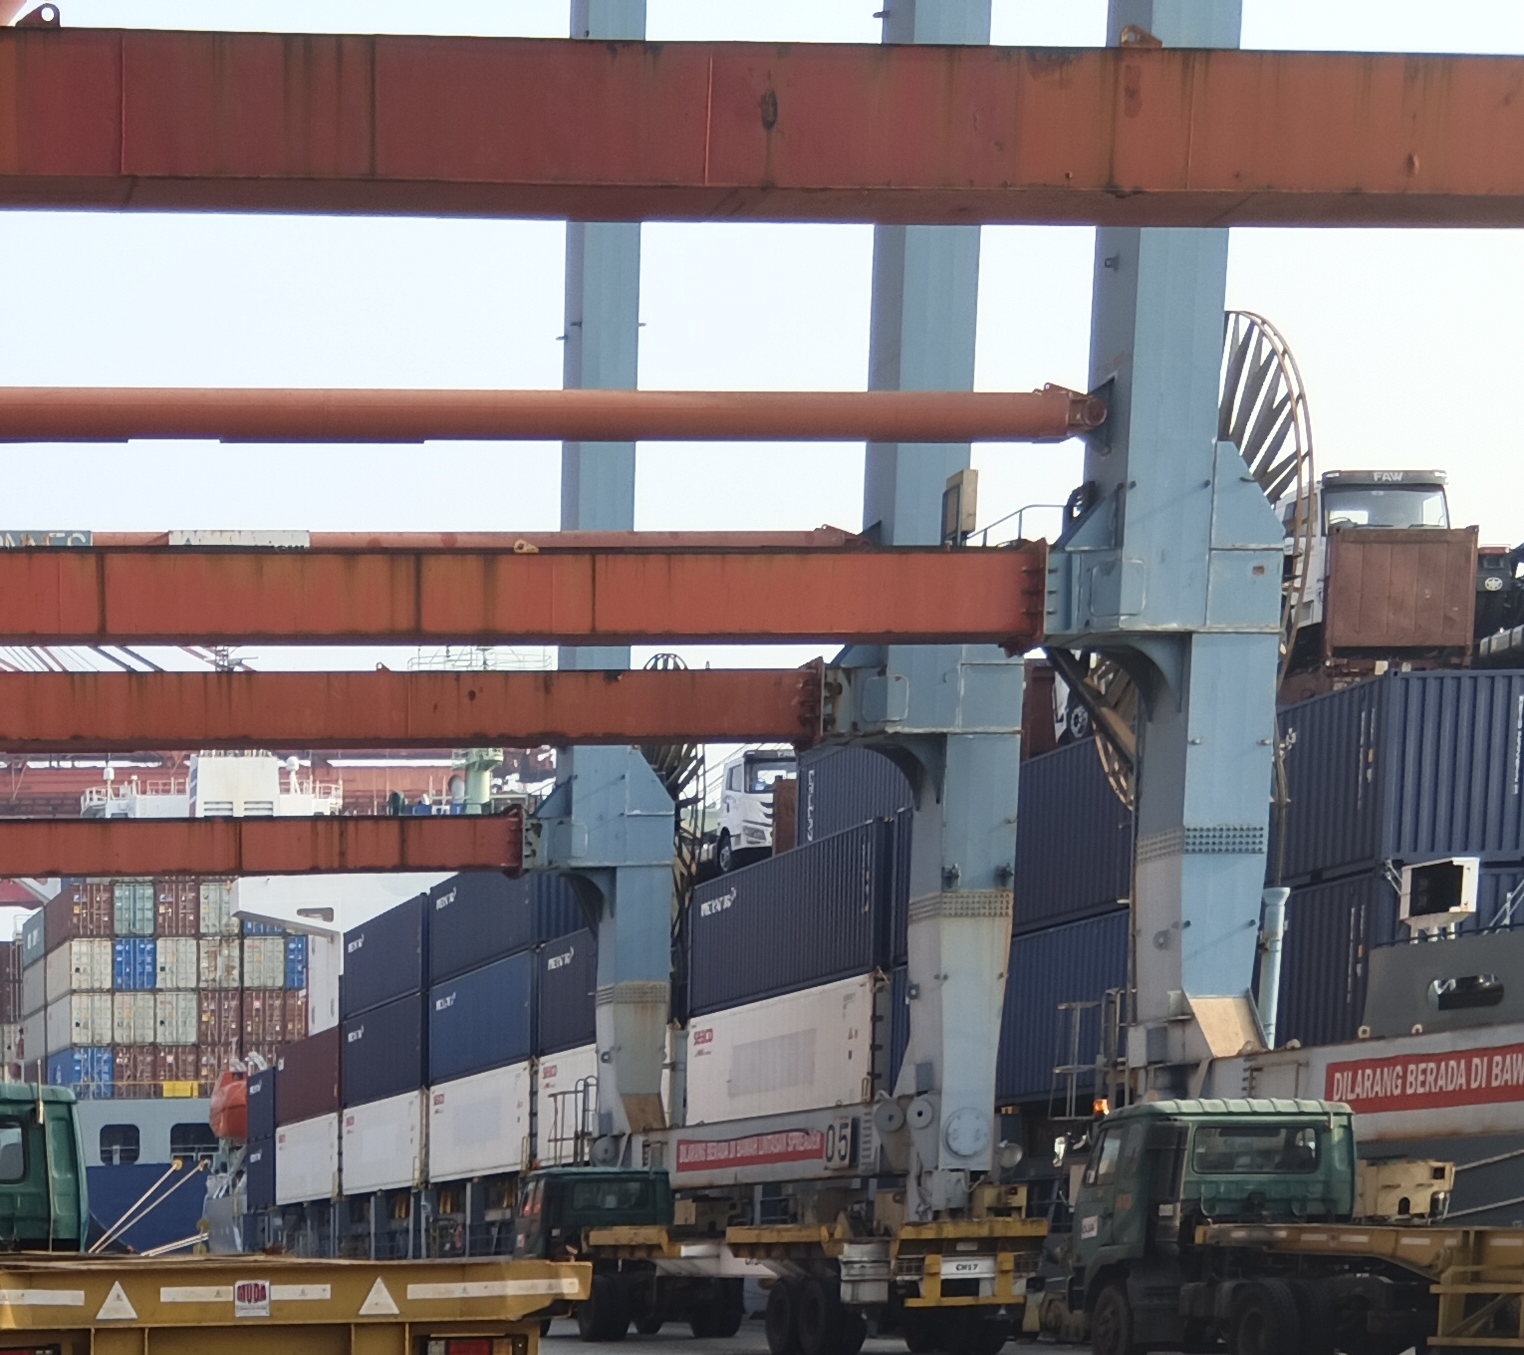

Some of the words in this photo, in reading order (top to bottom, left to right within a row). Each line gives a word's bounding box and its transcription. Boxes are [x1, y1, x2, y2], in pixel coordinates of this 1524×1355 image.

[1373, 472, 1404, 482] FAW
[1333, 1065, 1403, 1101] DILARANG
[1406, 1059, 1466, 1095] BERADA
[1470, 1056, 1488, 1089] DI
[826, 1122, 849, 1162] 05
[236, 1283, 267, 1304] MUDA
